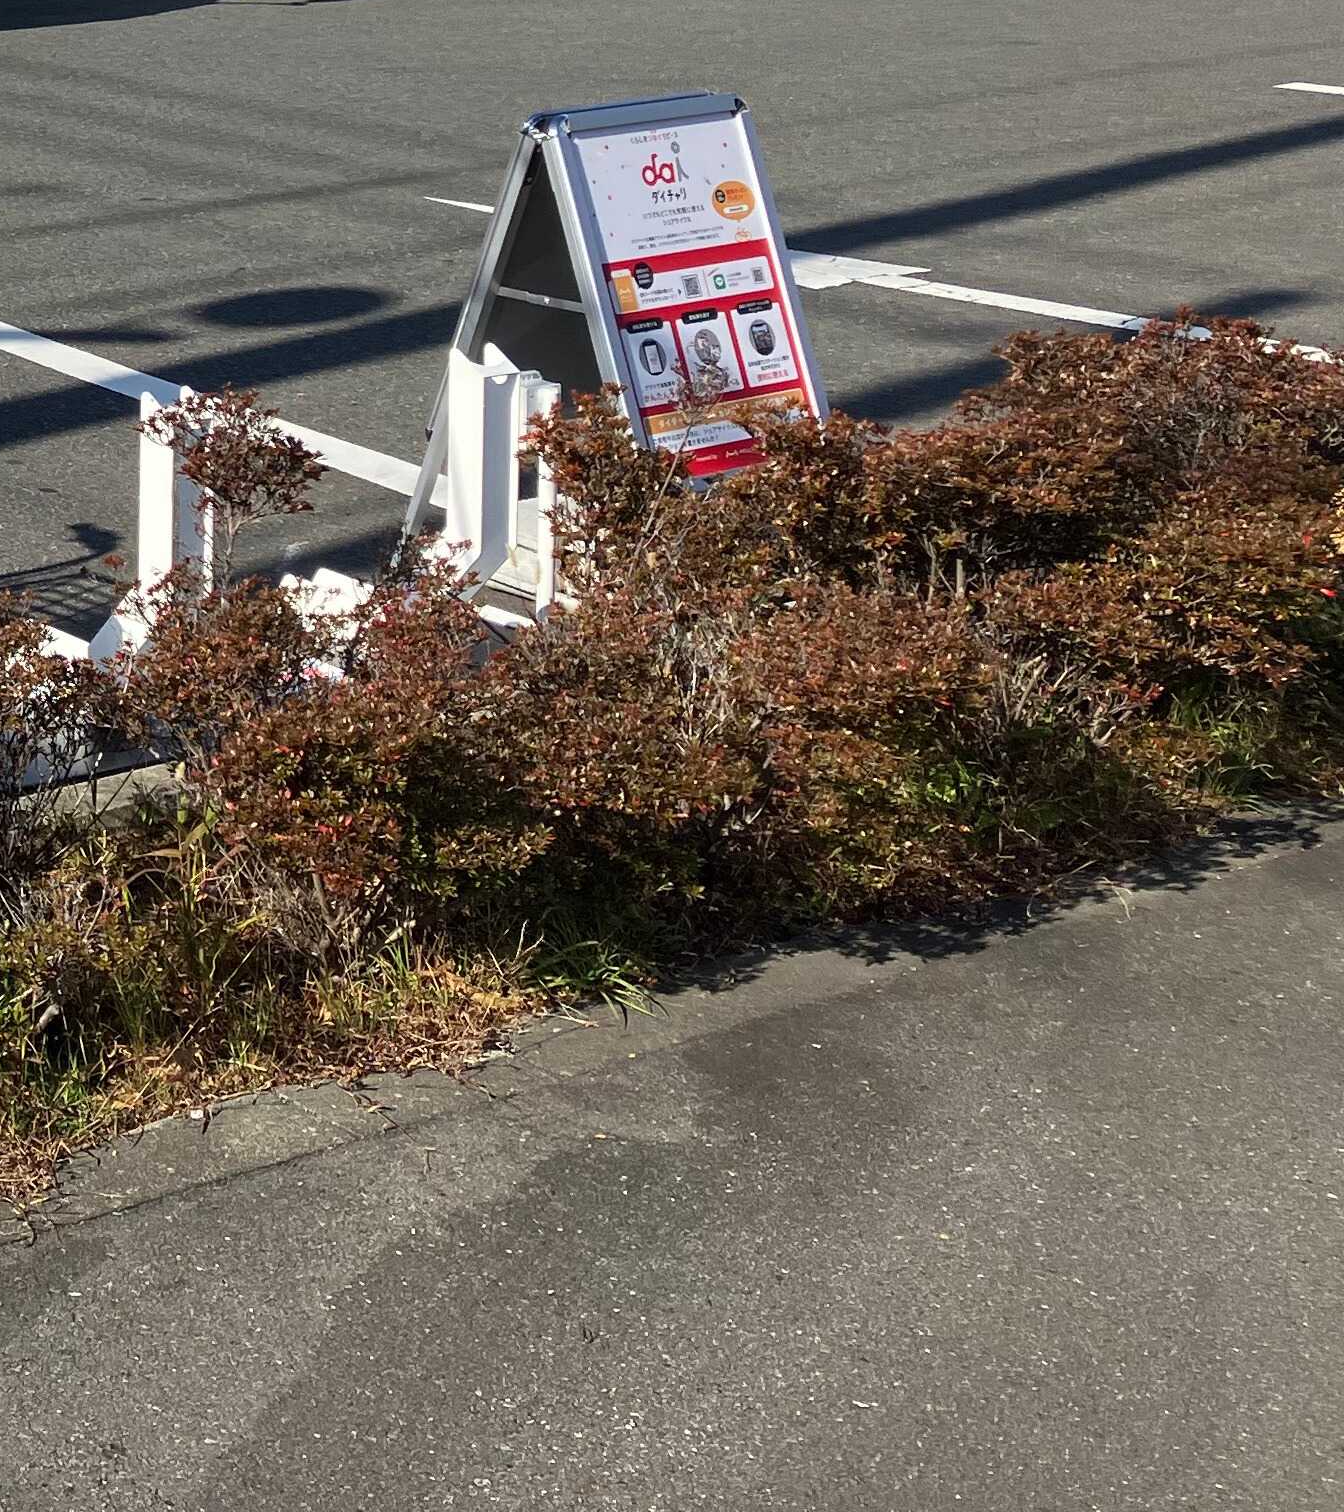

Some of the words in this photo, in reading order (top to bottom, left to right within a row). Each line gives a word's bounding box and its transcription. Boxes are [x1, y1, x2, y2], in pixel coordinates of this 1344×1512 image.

[651, 187, 687, 205] ダイチャリ
